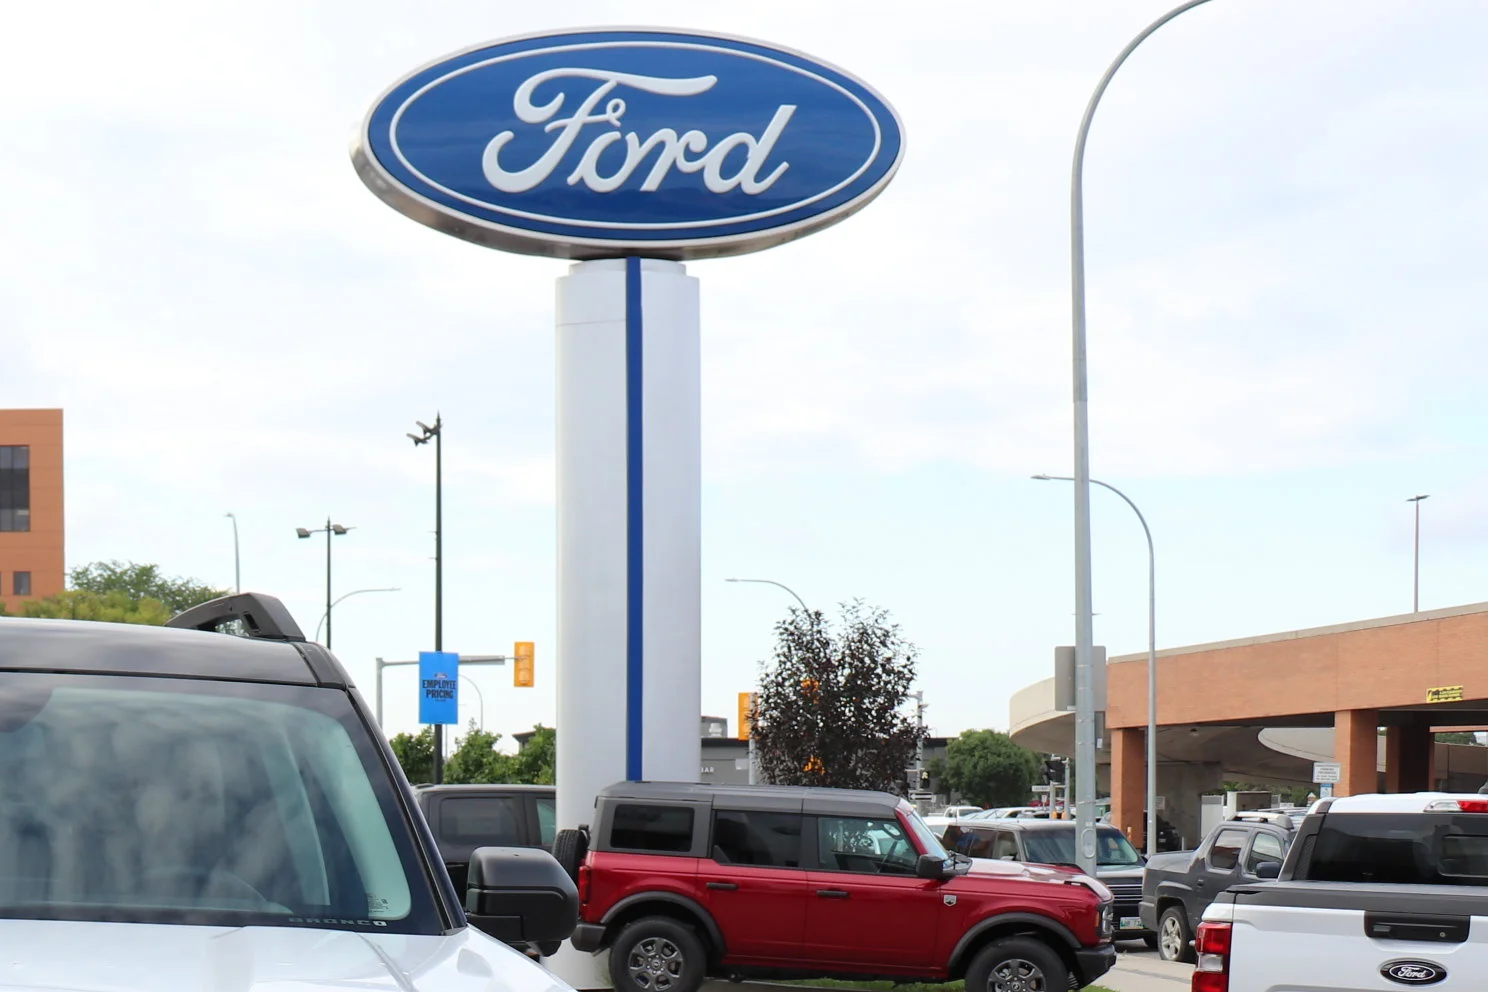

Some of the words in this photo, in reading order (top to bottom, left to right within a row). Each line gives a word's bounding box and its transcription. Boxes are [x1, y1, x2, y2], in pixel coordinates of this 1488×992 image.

[482, 67, 797, 195] Ford
[422, 679, 456, 690] EMPLOYEE
[426, 689, 454, 699] PRICING
[1397, 965, 1427, 979] Ford
